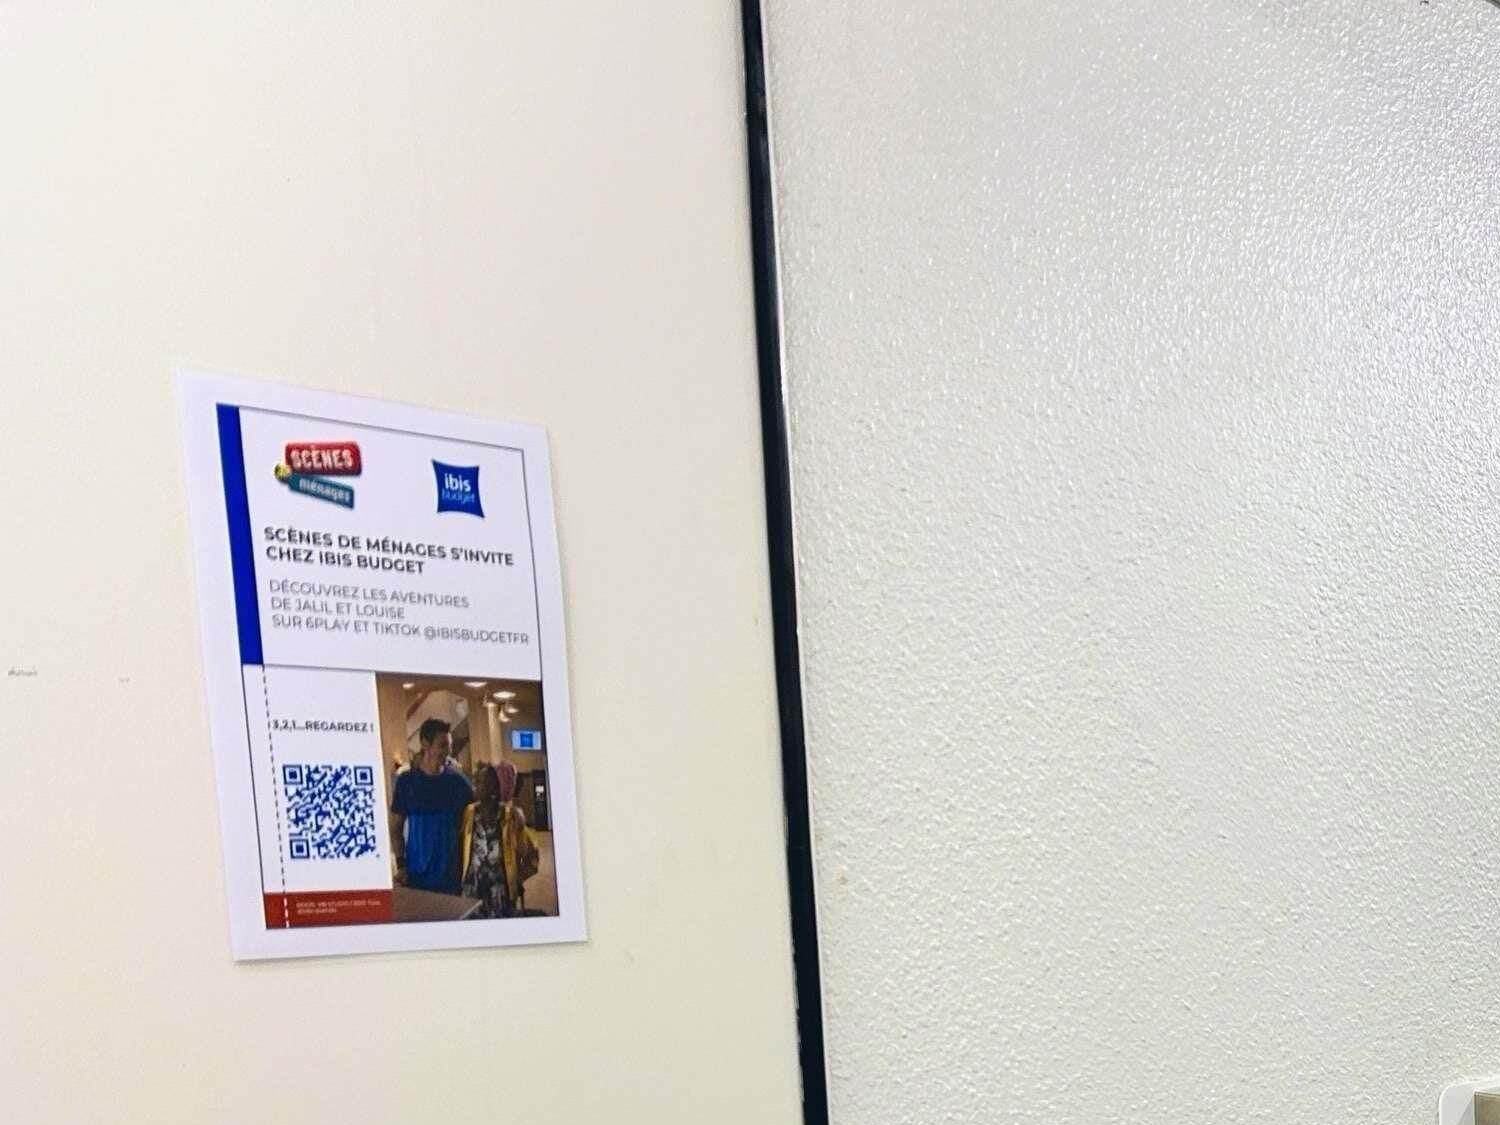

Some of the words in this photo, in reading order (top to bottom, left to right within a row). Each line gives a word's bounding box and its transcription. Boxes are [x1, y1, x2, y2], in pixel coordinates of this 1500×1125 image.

[444, 473, 471, 492] ibis
[264, 525, 333, 547] SCÈNES
[338, 534, 361, 550] DE
[366, 536, 447, 559] MÉNAGES
[451, 547, 514, 566] S'INVITE
[266, 545, 313, 563] CHEZ
[319, 551, 352, 567] IBIS
[357, 555, 424, 573] BUDGET
[269, 578, 360, 599] DÉCOUVREZ
[363, 588, 387, 601] LES
[390, 591, 469, 608] AVENTURES
[271, 597, 290, 611] DE
[296, 598, 332, 614] JALIL
[336, 602, 352, 615] ET
[356, 604, 405, 620] LOUISE
[272, 613, 301, 629] SUR
[306, 616, 350, 632] 6PLAY
[354, 620, 369, 633] ET
[373, 621, 420, 636] TIKTOK
[424, 626, 529, 644] @IBISBUDGETFR
